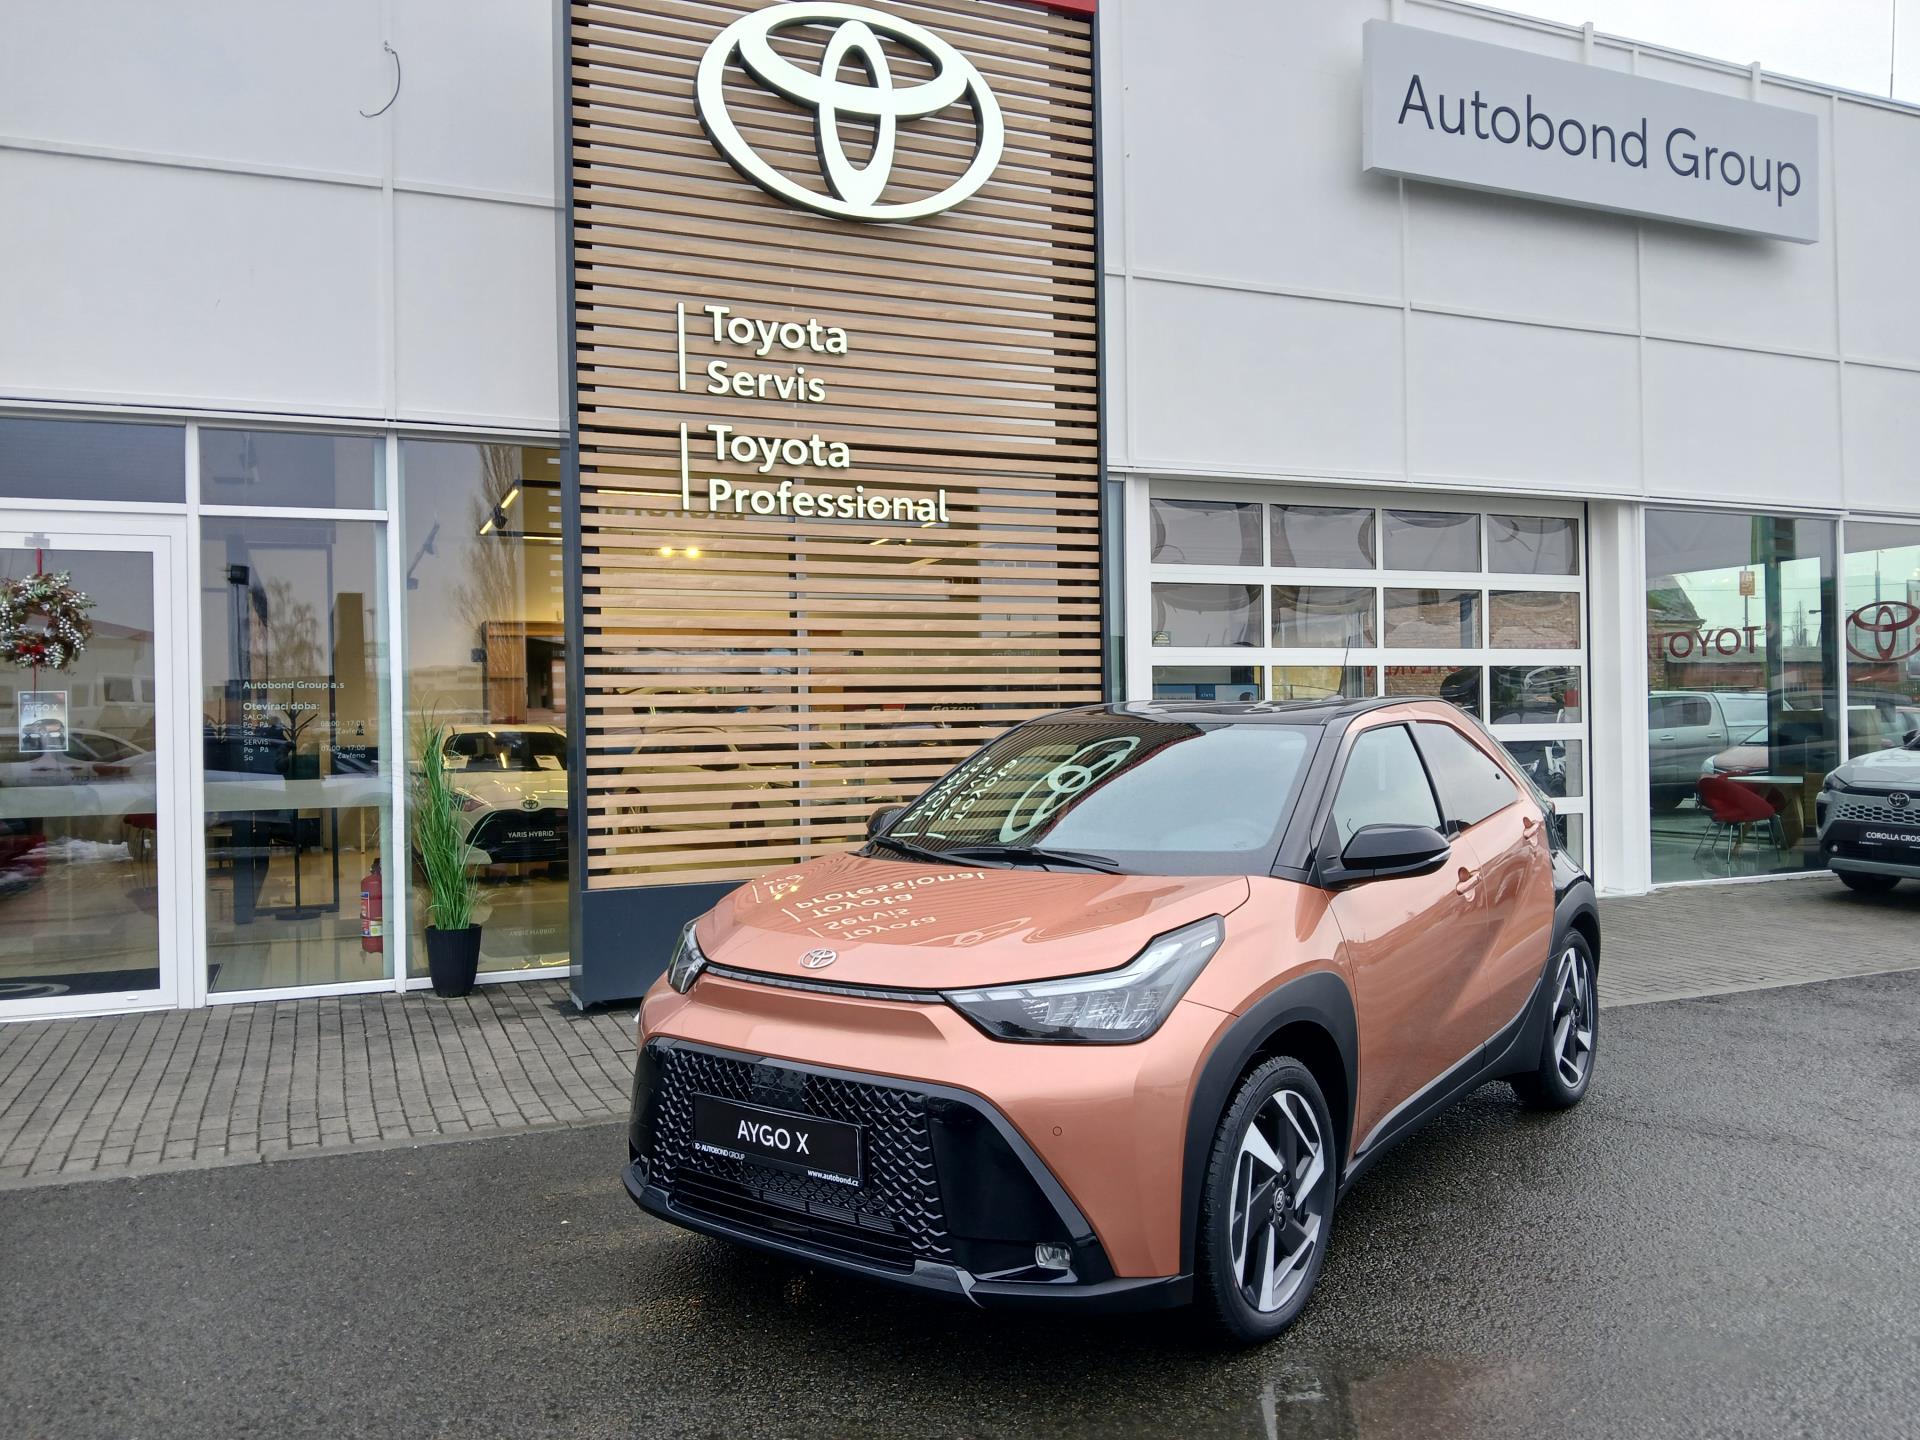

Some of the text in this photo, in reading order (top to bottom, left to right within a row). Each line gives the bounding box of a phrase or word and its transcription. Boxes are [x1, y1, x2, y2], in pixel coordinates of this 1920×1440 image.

[1398, 73, 1801, 207] Autobond Group
[704, 304, 849, 356] Toyota
[706, 360, 827, 403] Servis
[707, 423, 851, 473] Toyota
[708, 478, 951, 523] Professional
[243, 681, 294, 690] Autobond
[296, 681, 329, 691] Group
[507, 830, 555, 839] YARIS HYBRID
[1866, 831, 1900, 841] COROLLA
[701, 1144, 745, 1160] AUTOBOND GROUP
[737, 1119, 810, 1155] AYGO X
[807, 1169, 859, 1187] www.autobond.cz
